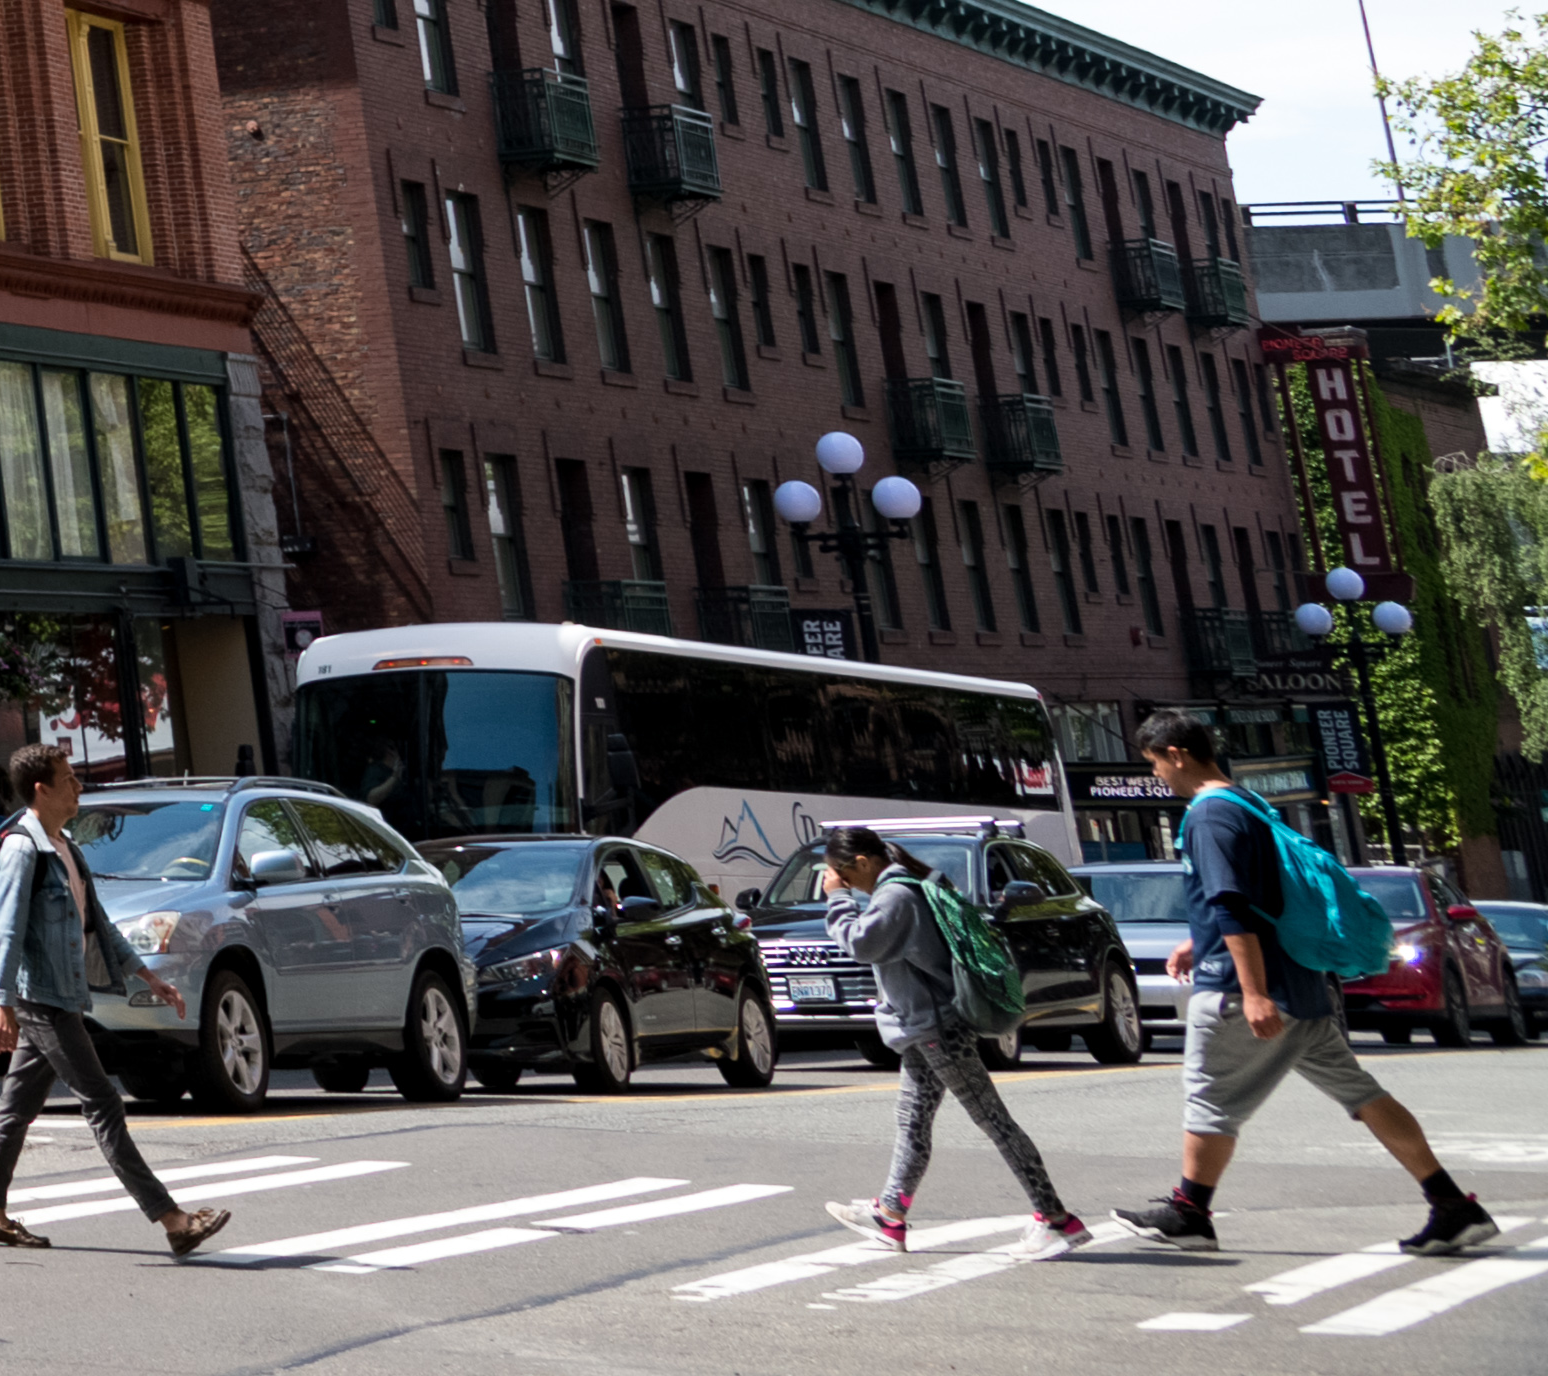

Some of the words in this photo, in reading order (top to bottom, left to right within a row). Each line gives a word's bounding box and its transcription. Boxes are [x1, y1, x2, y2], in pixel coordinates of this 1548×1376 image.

[1315, 367, 1381, 566] HOTEL
[1246, 673, 1343, 692] SALOON
[1317, 709, 1343, 770] PIONEER
[1333, 709, 1360, 770] SQUARE
[1090, 786, 1145, 797] PIONEER
[1145, 786, 1174, 798] SQU
[1095, 776, 1124, 787] BEST
[1125, 776, 1165, 787] WESTE
